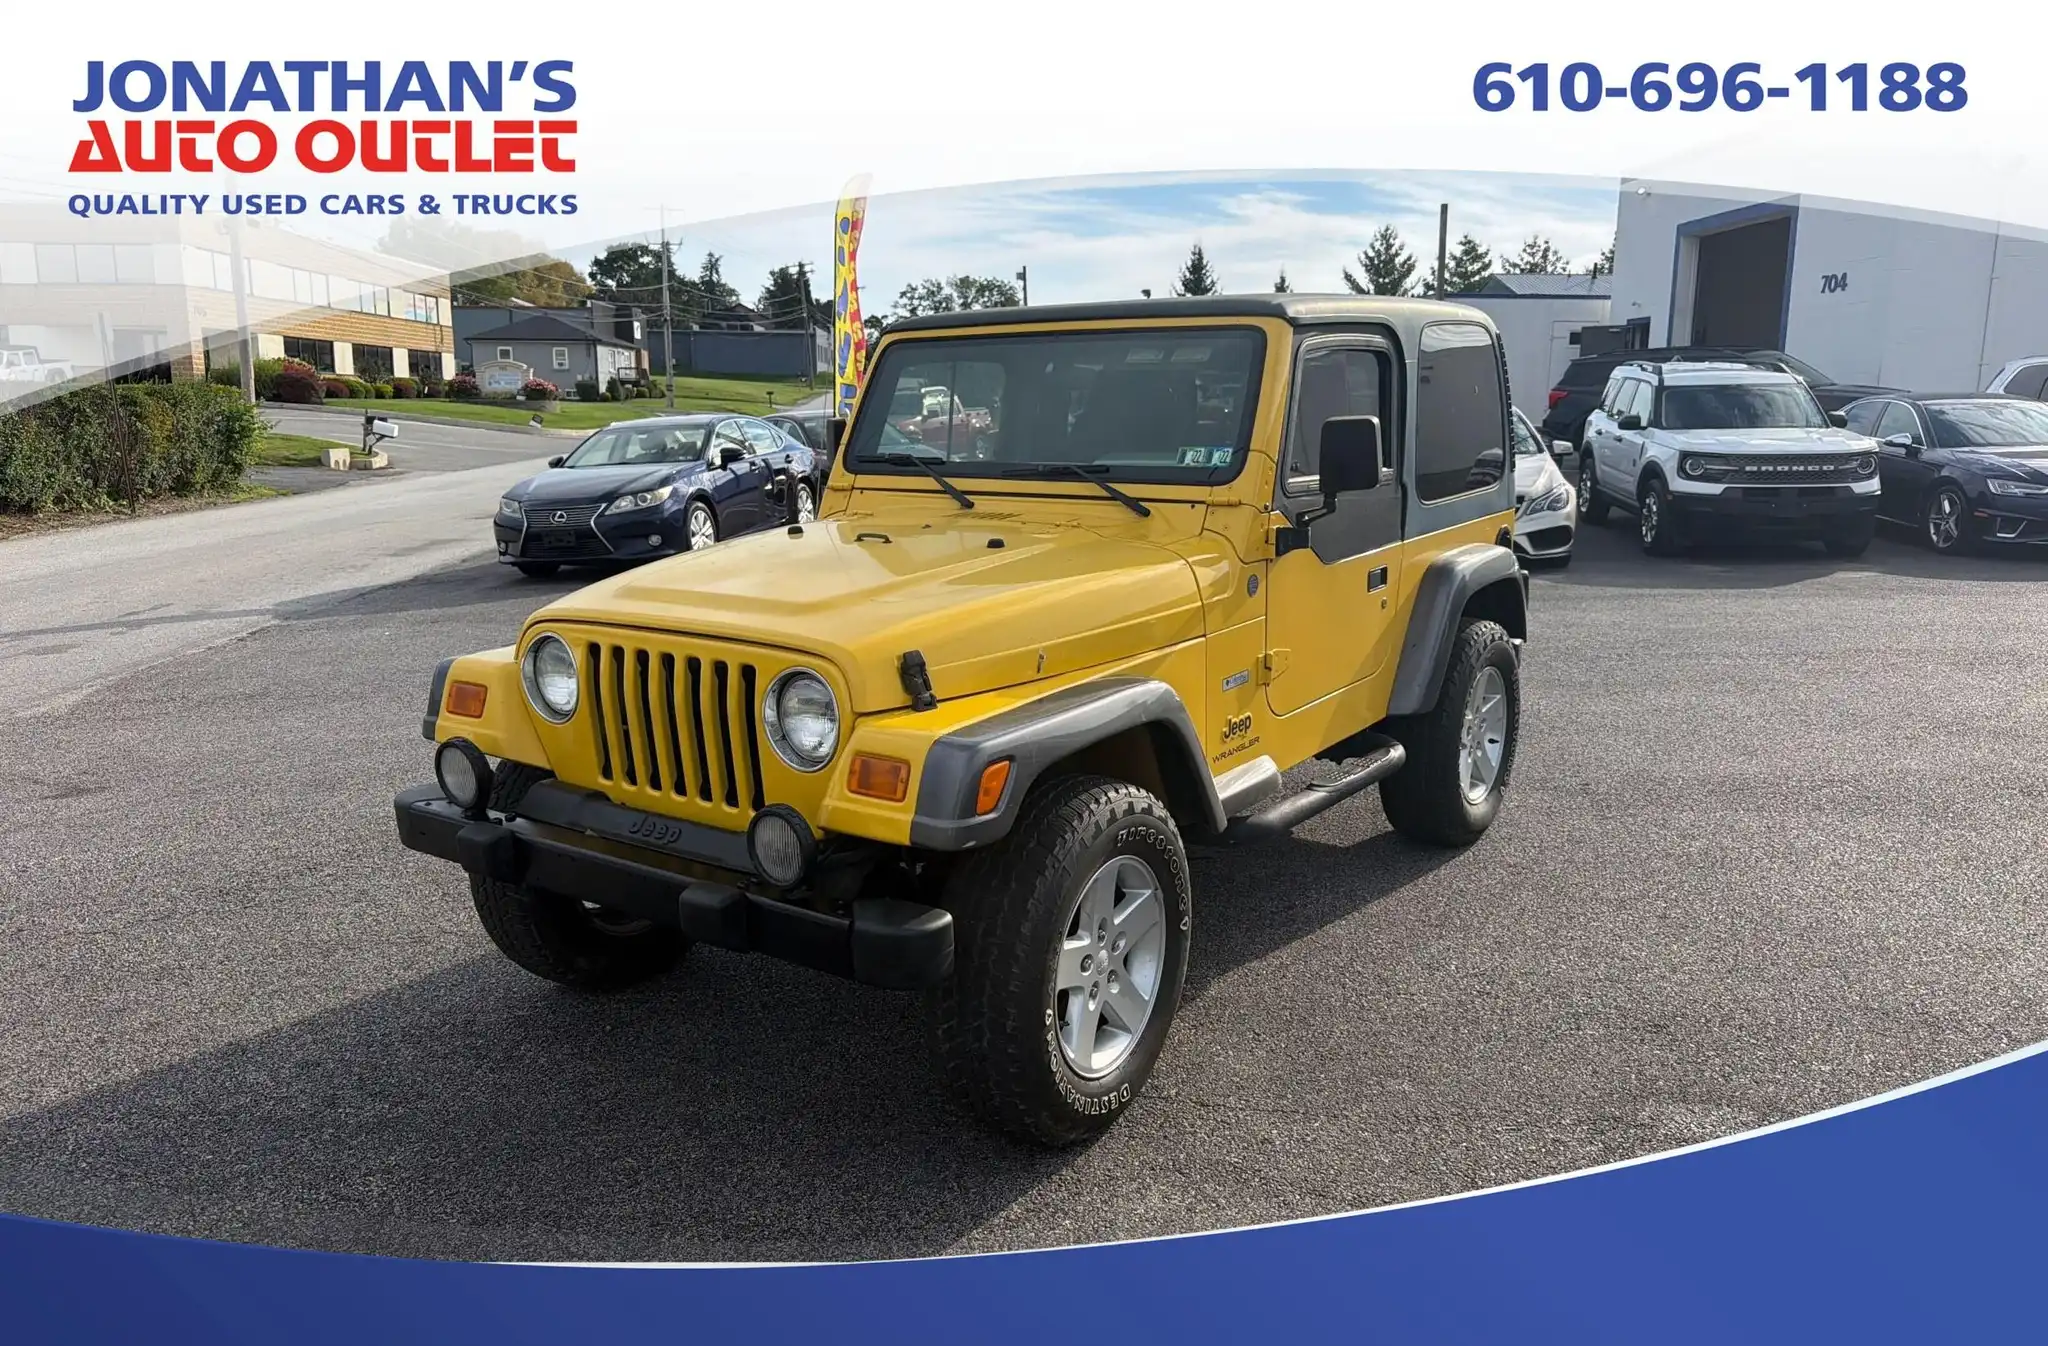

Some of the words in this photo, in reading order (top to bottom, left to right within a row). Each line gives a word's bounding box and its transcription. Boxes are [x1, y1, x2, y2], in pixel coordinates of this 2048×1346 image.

[1820, 272, 1848, 294] 704
[1223, 713, 1252, 740] Jeep
[1212, 736, 1261, 764] WRANGLER
[628, 814, 683, 846] Jeep
[1045, 1030, 1131, 1115] DESTINATION
